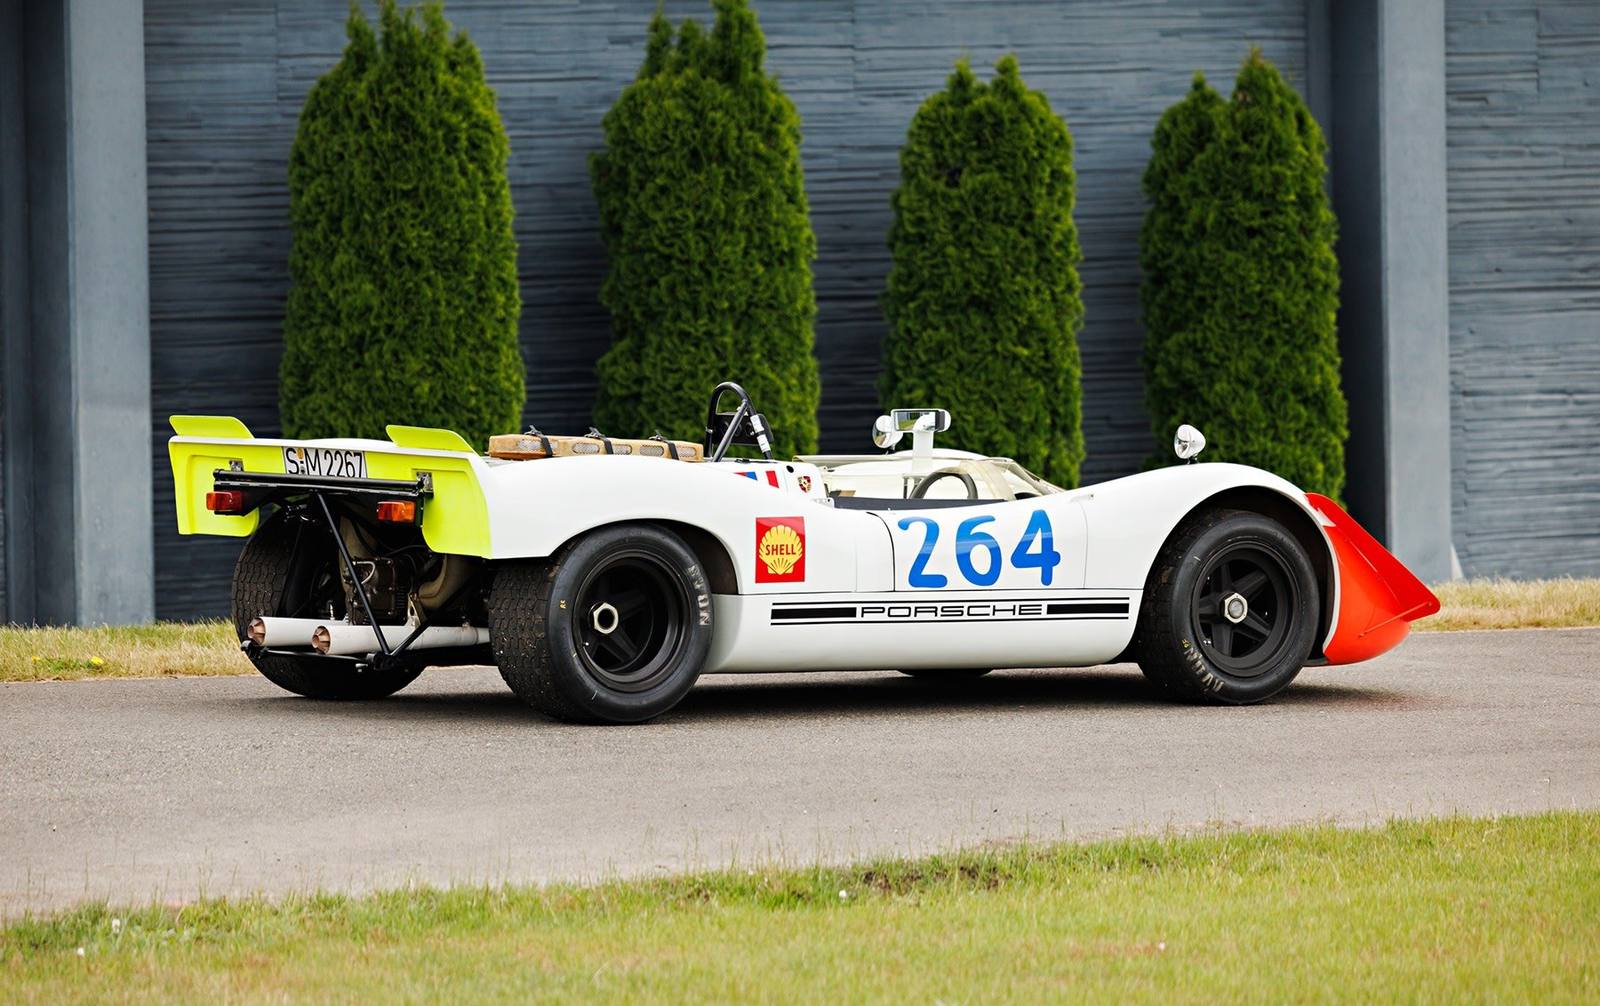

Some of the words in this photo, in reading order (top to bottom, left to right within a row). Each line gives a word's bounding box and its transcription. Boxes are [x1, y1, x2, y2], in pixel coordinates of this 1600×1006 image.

[324, 449, 363, 478] 2267
[765, 544, 797, 556] SHELL
[897, 509, 1061, 588] 264
[861, 604, 1043, 618] PORSCHE
